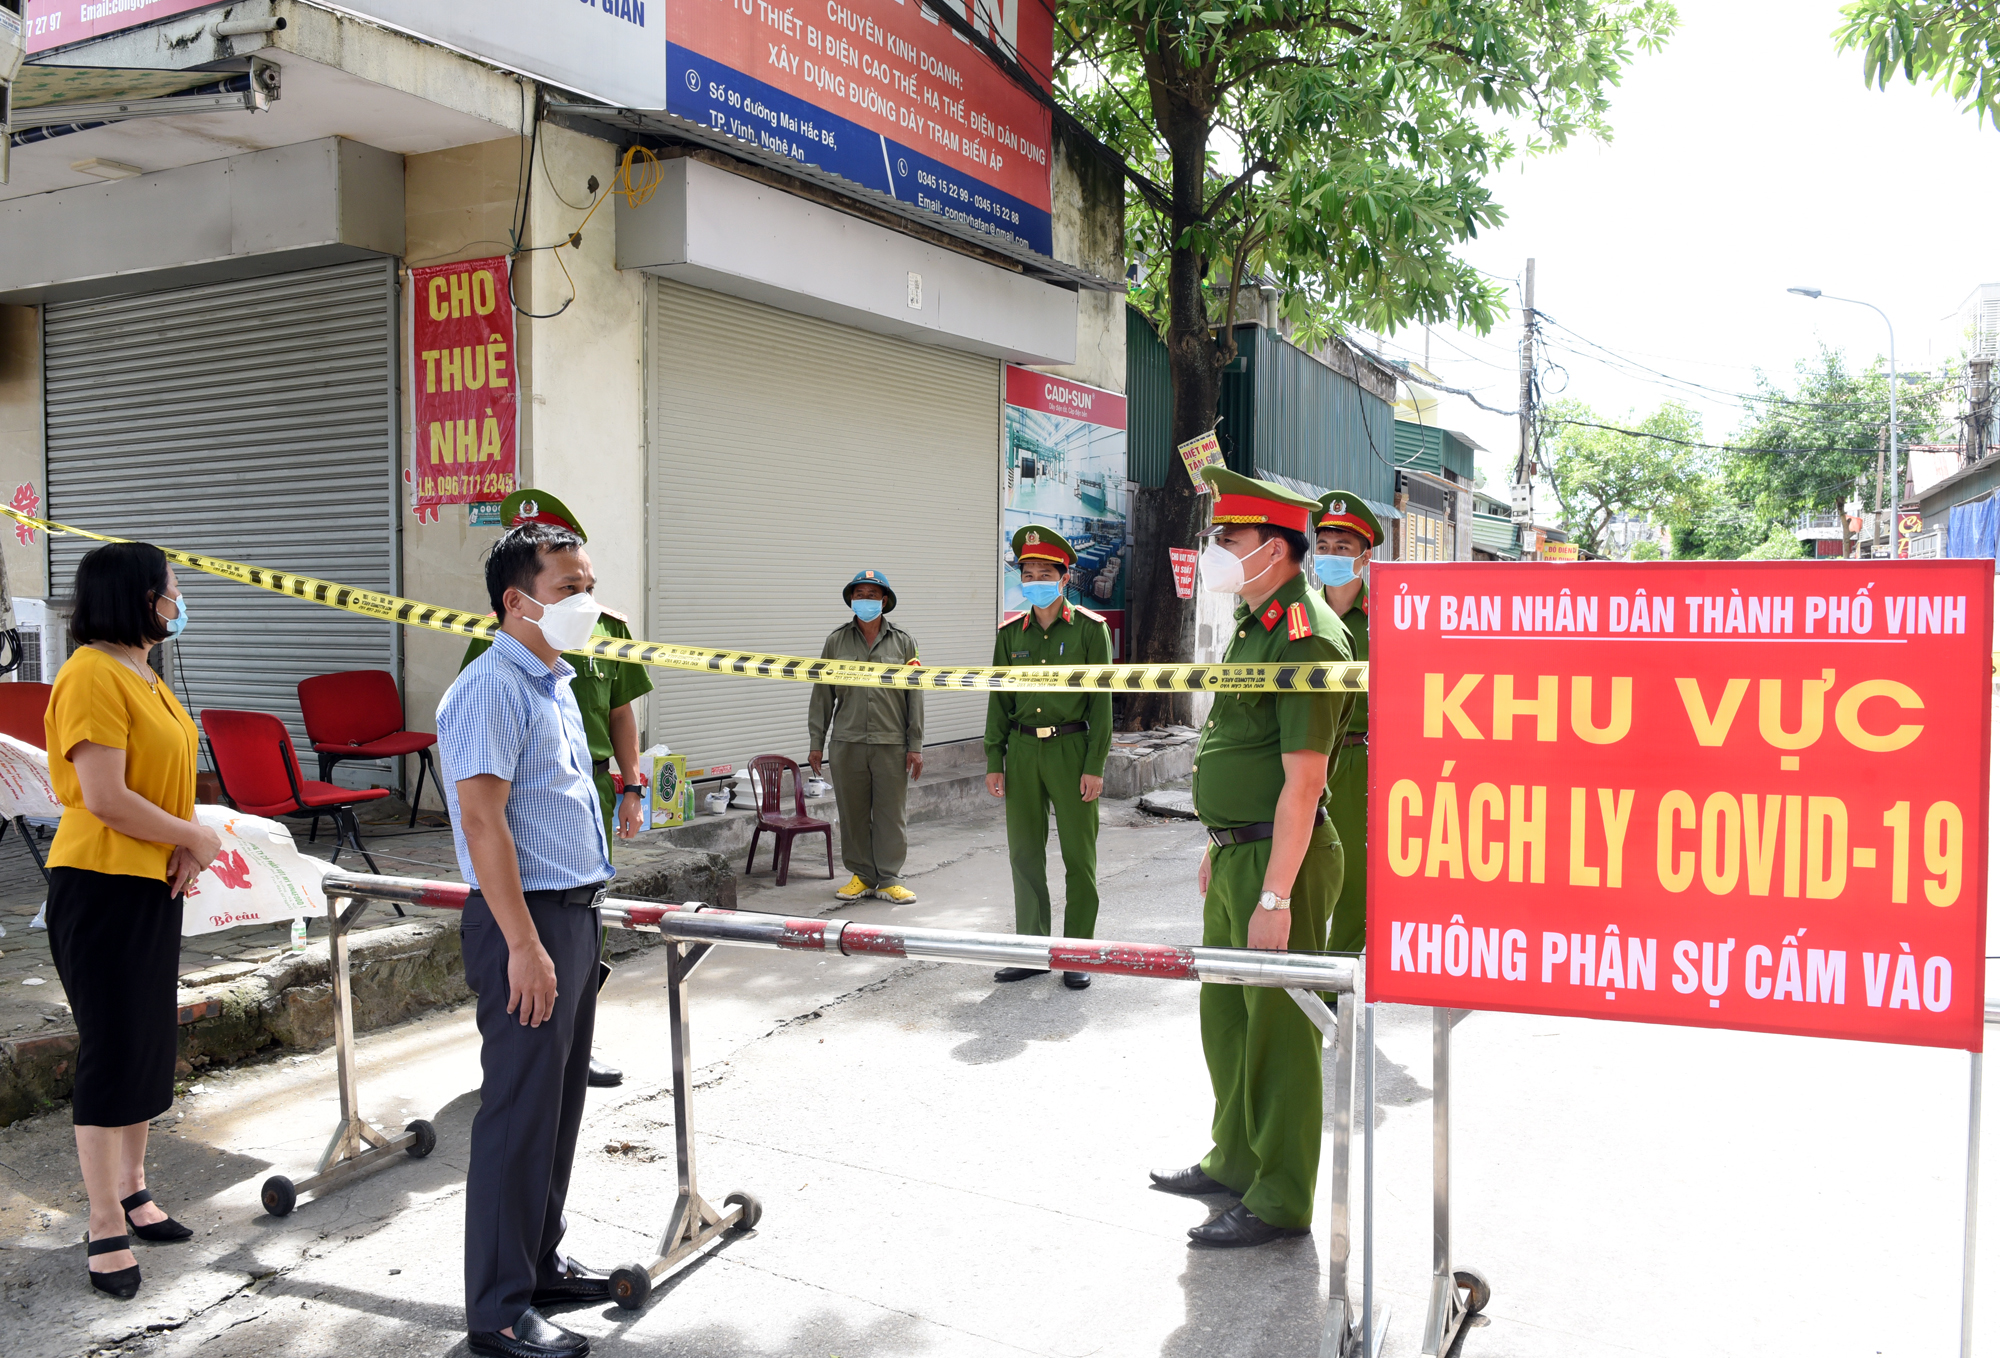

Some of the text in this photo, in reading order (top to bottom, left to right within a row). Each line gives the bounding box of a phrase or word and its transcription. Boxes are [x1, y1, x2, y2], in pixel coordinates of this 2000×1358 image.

[35, 16, 47, 35] 27
[50, 12, 62, 31] 97
[827, 0, 884, 47] CHUYÊN
[887, 33, 917, 65] KINH
[920, 51, 963, 91] DOANH:
[758, 0, 802, 39] THIẾT
[807, 25, 822, 55] BỊ
[826, 35, 859, 69] ĐIỆN
[862, 54, 890, 84] CAO
[892, 69, 920, 104] THẾ,
[924, 86, 940, 114] HẠ
[942, 96, 968, 128] THẾ,
[970, 110, 995, 139] ĐIỆN
[997, 126, 1018, 151] DÂN
[1020, 138, 1046, 166] DỤNG
[768, 42, 1004, 172] XÂY DỰNG ĐƯỜNG DÂY TRẠM BIẾN ÁP
[709, 82, 837, 151] Số 90 đường Mai Hắc Đế,
[709, 110, 727, 130] TP.
[730, 118, 758, 144] Vinh,
[791, 144, 805, 161] An
[918, 170, 936, 189] 0345
[938, 179, 948, 194] 15
[949, 184, 958, 198] 22
[960, 188, 968, 202] 99
[974, 195, 991, 213] 0345
[993, 203, 1000, 217] 15
[1002, 207, 1010, 221] 22
[1012, 211, 1020, 225] 88
[918, 193, 942, 214] Email:
[428, 269, 496, 322] CHO
[422, 333, 509, 394] THUÊ
[430, 408, 501, 464] NHÀ
[1182, 446, 1200, 460] DIỆT
[1202, 438, 1218, 452] MỐI
[419, 473, 514, 496] LH: 096 711 2345
[1188, 458, 1205, 472] TẬN
[1393, 582, 1966, 635] ỦY BAN NHÂN DÂN THÀNH PHỐ VINH
[1423, 668, 1925, 770] KHU VỰC
[1386, 760, 1964, 908] CÁCH LY COVID-19
[235, 912, 261, 921] câu
[1390, 914, 1952, 1012] KHÔNG PHẬN SỰ CẤM VÀO
